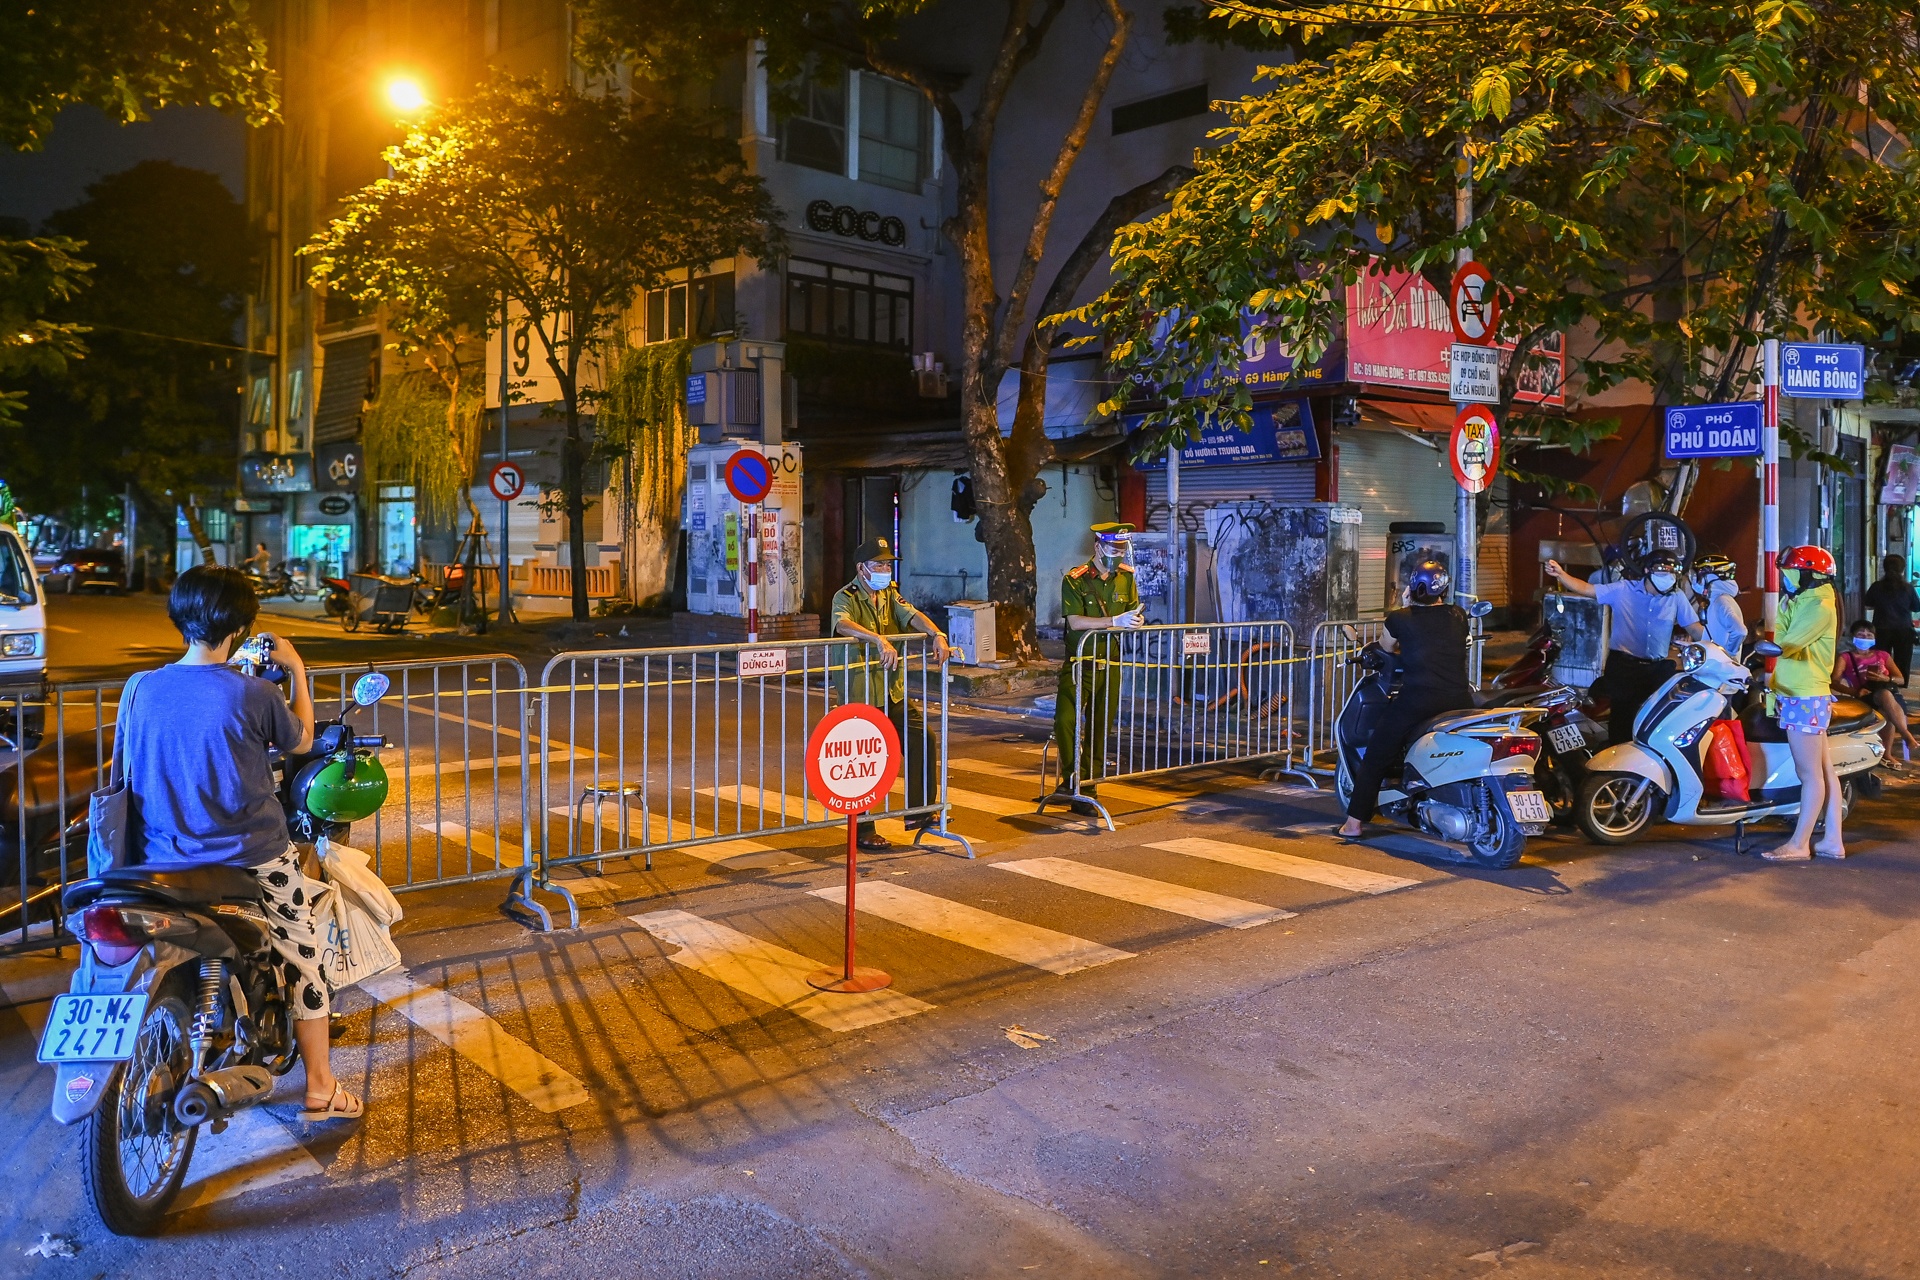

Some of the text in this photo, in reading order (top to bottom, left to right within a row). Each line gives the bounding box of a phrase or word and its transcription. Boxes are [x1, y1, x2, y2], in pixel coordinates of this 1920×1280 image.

[1453, 350, 1460, 361] XE
[1460, 352, 1471, 363] HỢP
[1815, 352, 1839, 364] PHỐ
[1245, 373, 1259, 385] 69
[1263, 370, 1290, 384] Hàng
[1364, 364, 1372, 376] 69
[1372, 363, 1388, 378] HÀNG
[1389, 364, 1405, 379] BÔNG
[1460, 368, 1467, 378] 09
[1787, 365, 1857, 389] HÀNG BÔNG
[1705, 411, 1733, 425] PHỐ
[1466, 423, 1485, 438] TAXI
[1670, 425, 1756, 450] PHỦ DOÃN
[1217, 445, 1240, 455] TRUNG
[1240, 445, 1256, 454] HOA
[742, 658, 784, 670] DỪNG LẠI
[1552, 725, 1577, 742] 29-K1
[825, 736, 882, 758] KHU VỰC
[829, 757, 877, 781] CẤM
[828, 791, 877, 810] NO ENTRY
[1512, 793, 1540, 807] 30-L2
[1519, 807, 1544, 820] 2430
[63, 997, 134, 1026] 30-M4
[53, 1027, 125, 1057] 2471
